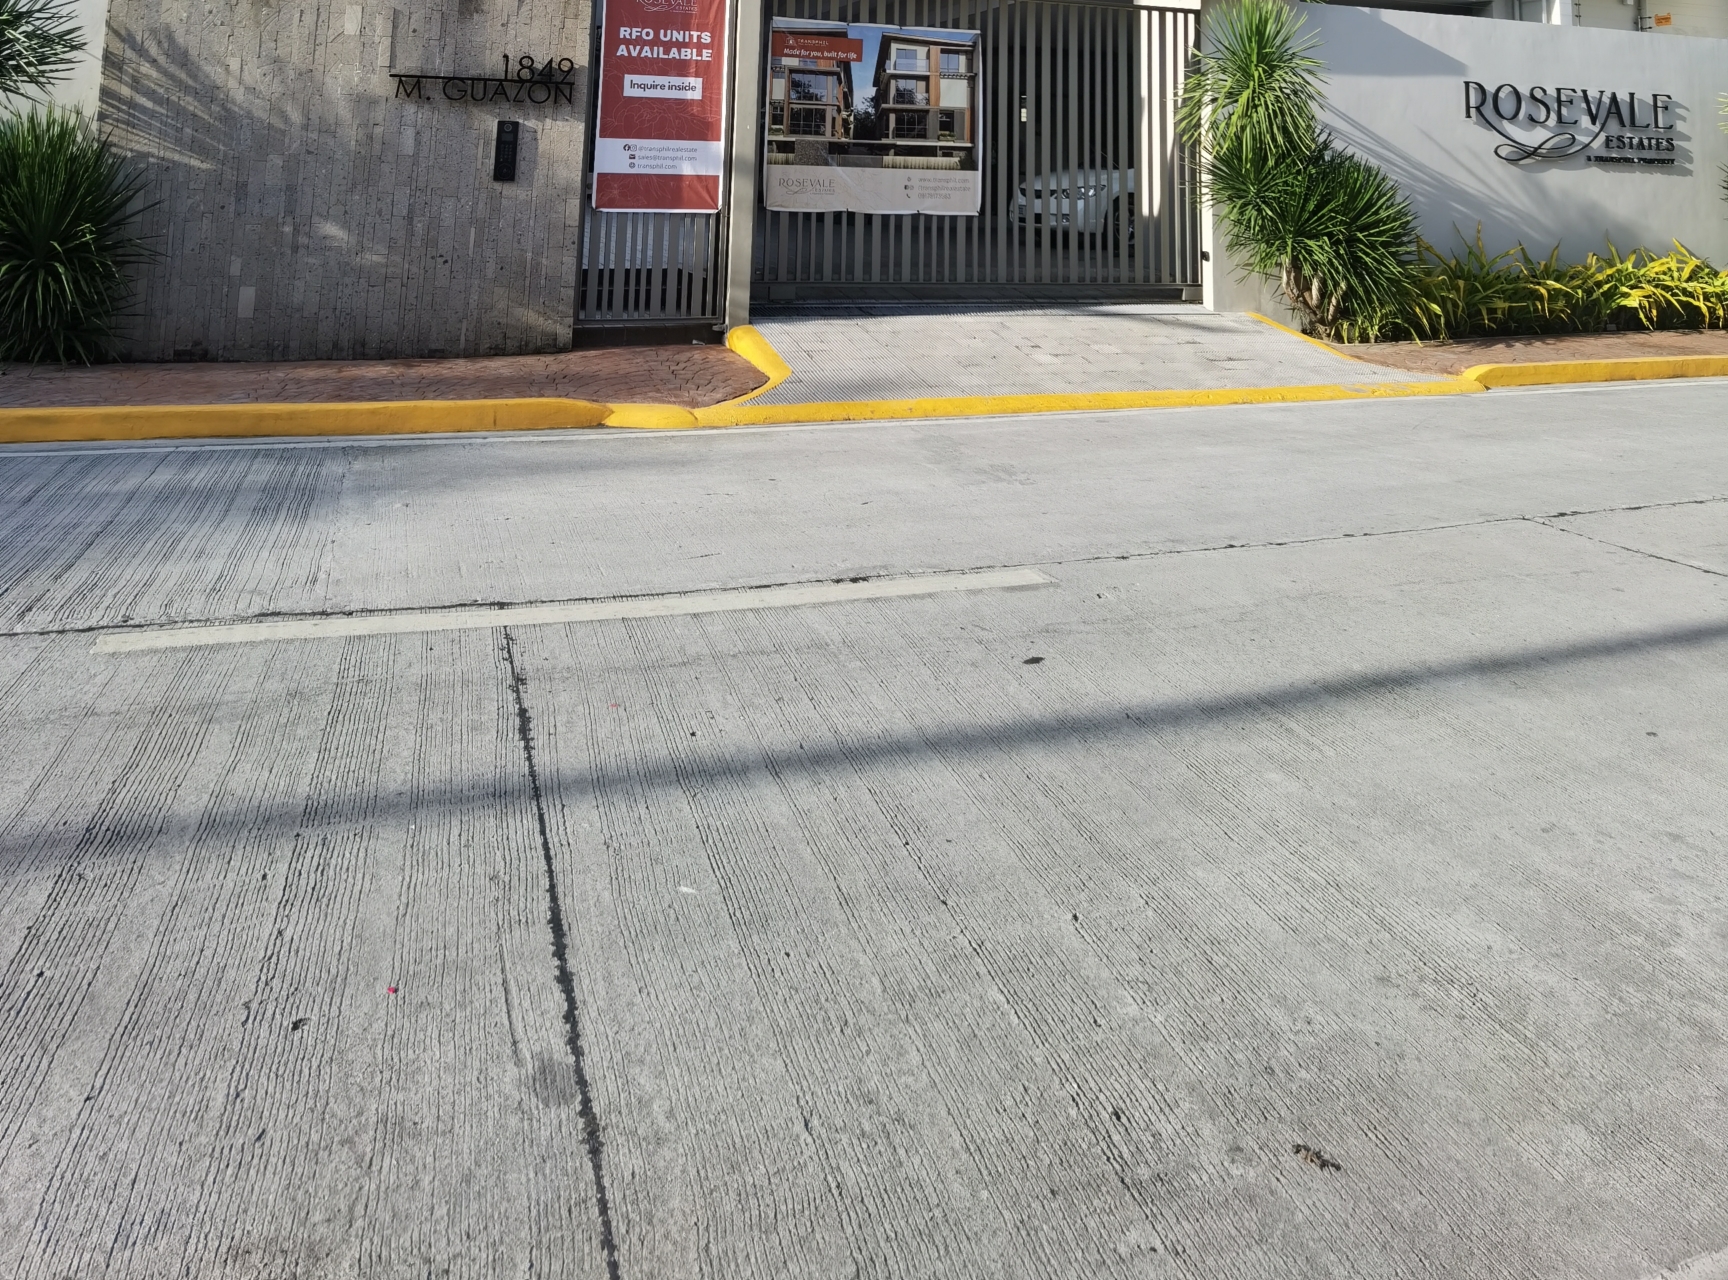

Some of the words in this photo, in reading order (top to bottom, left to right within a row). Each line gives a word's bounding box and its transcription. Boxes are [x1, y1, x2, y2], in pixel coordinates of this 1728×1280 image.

[619, 26, 654, 40] RFO
[659, 29, 712, 44] UNITS
[616, 44, 712, 61] AVAILABLE
[783, 48, 800, 56] Made
[800, 49, 810, 57] for
[810, 50, 822, 58] you,
[823, 50, 837, 58] built
[837, 51, 847, 59] for
[847, 52, 858, 60] life
[502, 53, 574, 82] 1849
[394, 77, 431, 101] M.
[442, 78, 573, 105] GUAZON
[630, 79, 666, 92] Inquire
[667, 81, 697, 92] inside
[1463, 81, 1674, 162] ROSEVALE
[638, 145, 698, 154] @transphilrealestate
[1604, 134, 1675, 152] ESTATES
[637, 154, 698, 162] sales@transphil.com
[637, 162, 678, 170] transphil.com
[778, 177, 836, 195] ROSEVALE
